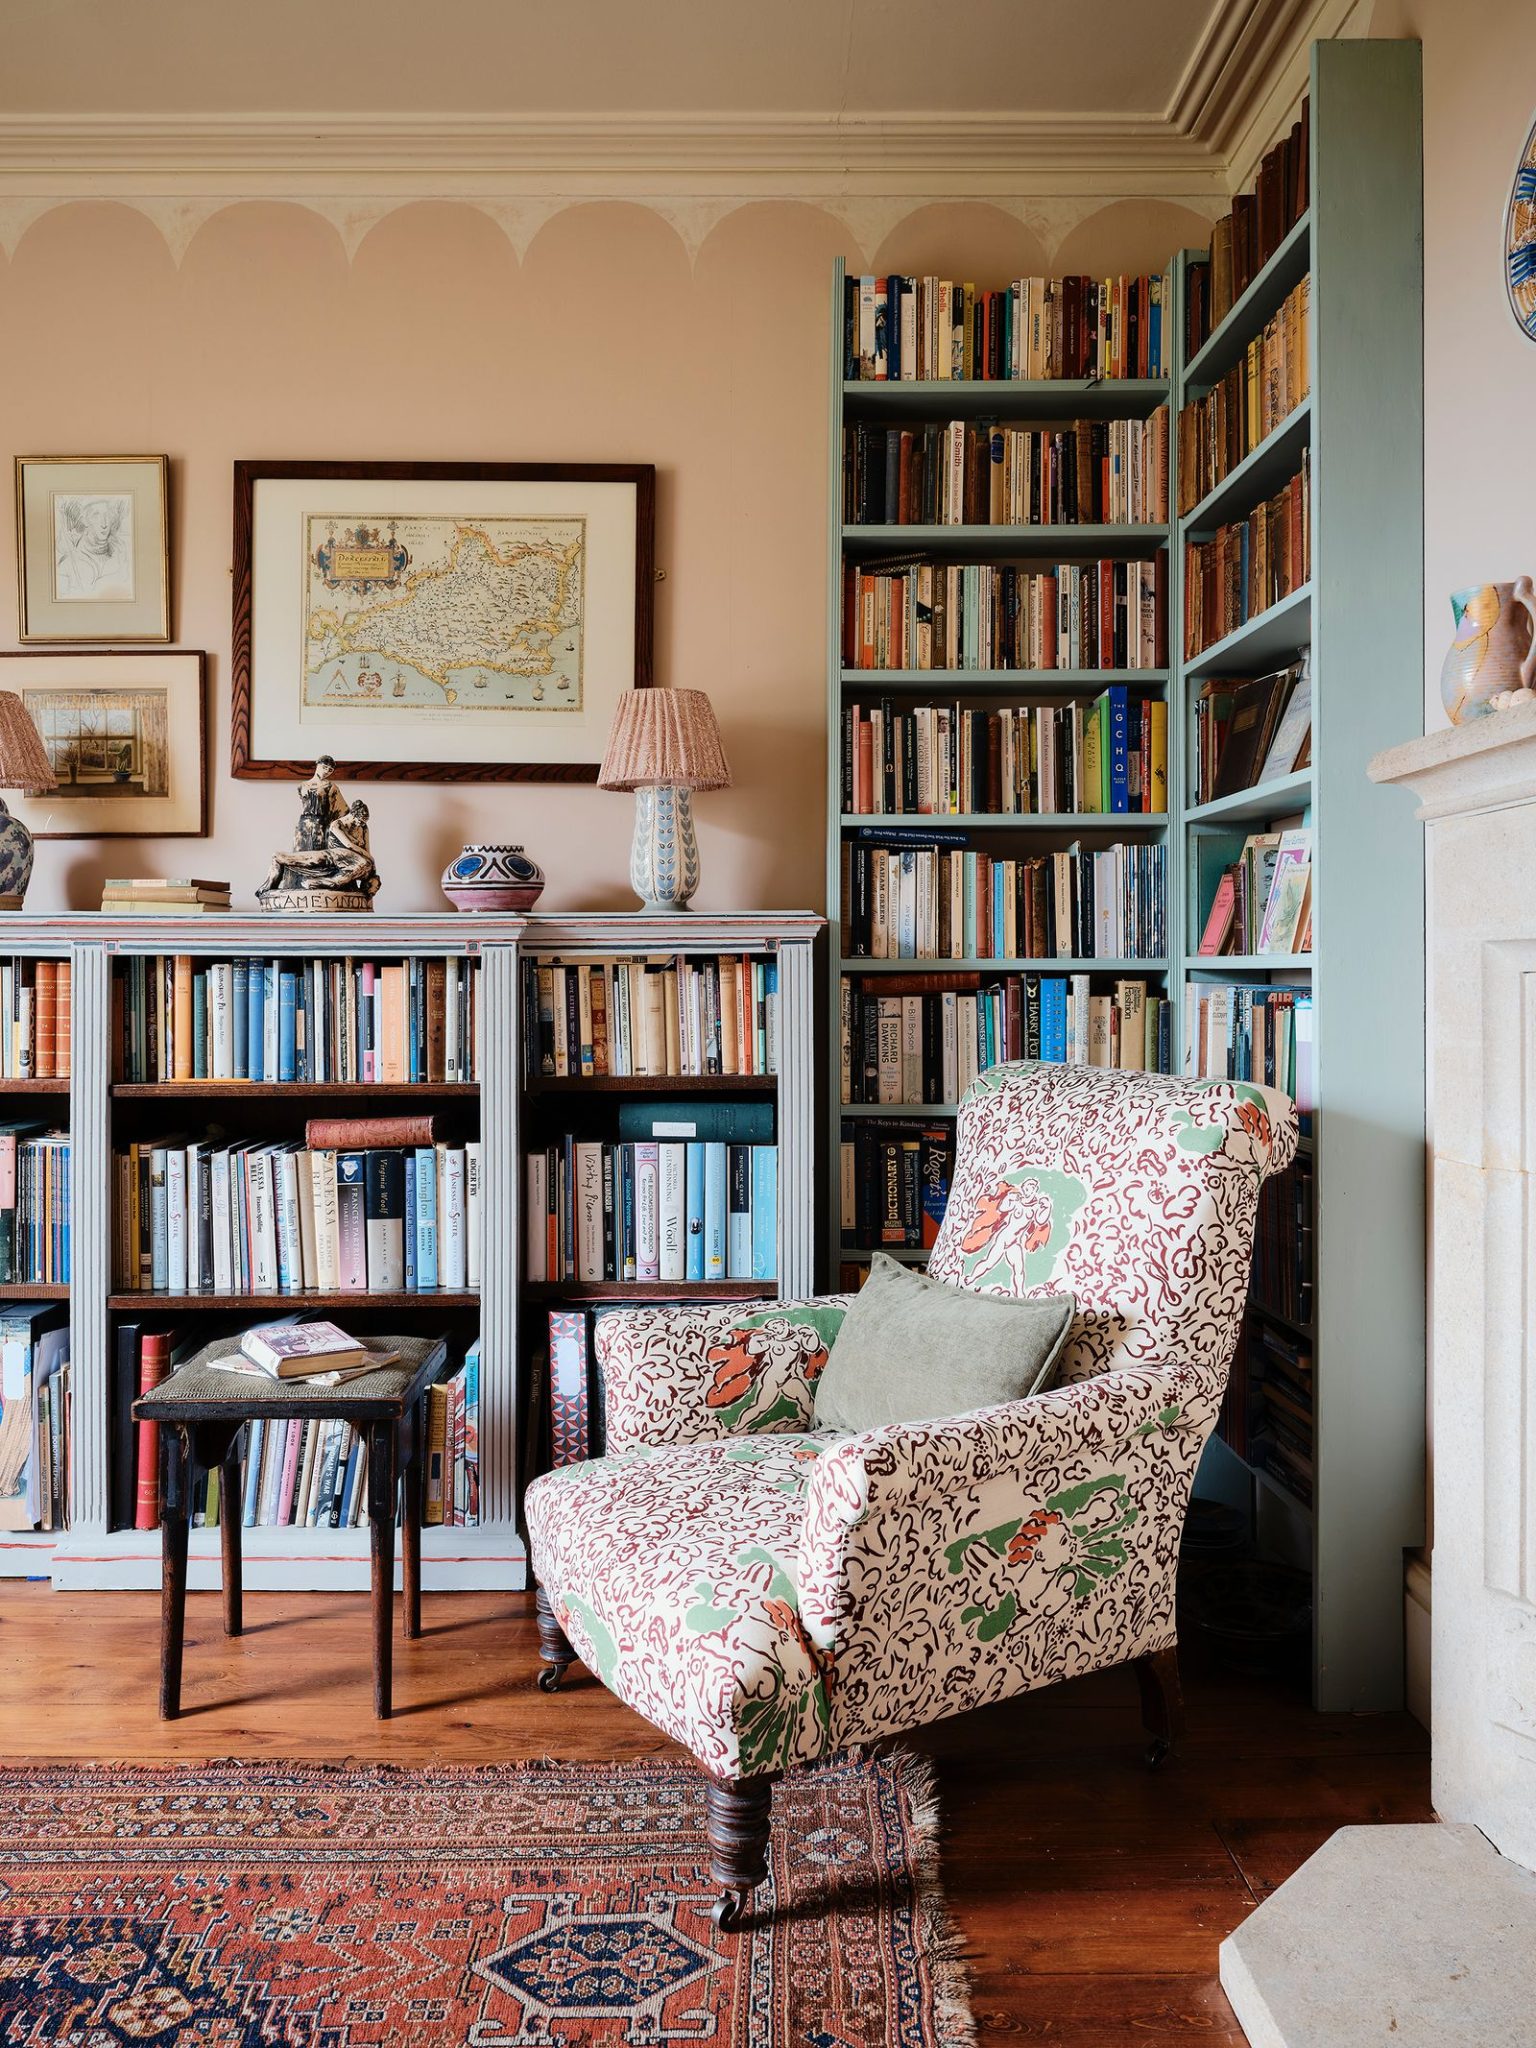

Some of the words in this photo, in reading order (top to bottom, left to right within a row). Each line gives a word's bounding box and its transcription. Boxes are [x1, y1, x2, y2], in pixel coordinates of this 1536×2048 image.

[939, 286, 947, 313] Shells
[954, 427, 963, 439] Ali
[954, 441, 963, 467] Smith
[1160, 478, 1168, 504] TODAY
[908, 1008, 916, 1021] Bill
[1124, 986, 1133, 1020] Fashion
[869, 1005, 877, 1035] DONNA
[978, 1012, 986, 1042] JAPANESE
[1029, 1001, 1039, 1035] HARRY
[881, 1023, 889, 1064] DAWKINS
[889, 1023, 898, 1064] RICHARD
[907, 1023, 916, 1051] Bryson
[979, 1042, 987, 1066] DESIGN
[877, 1119, 892, 1127] Keys
[899, 1120, 926, 1128] Kindness
[256, 1156, 265, 1191] VANESSA
[272, 1153, 282, 1191] QUENTIN
[379, 1158, 388, 1189] Virginia
[581, 1153, 598, 1190] Visiting
[604, 1154, 612, 1174] WOMEN
[904, 1152, 913, 1183] English
[923, 1146, 947, 1198] Roget's
[406, 1172, 414, 1187] The
[417, 1156, 434, 1218] Carrington
[450, 1171, 461, 1203] VANESSA
[470, 1183, 478, 1197] FRY
[887, 1159, 899, 1220] DICTIONARY
[275, 1192, 284, 1213] BELL
[351, 1187, 359, 1225] FRANCES
[379, 1192, 389, 1216] Woolf
[405, 1188, 414, 1209] Angel
[584, 1193, 599, 1223] Picasso
[604, 1181, 613, 1213] BLOOMSBURY
[904, 1184, 914, 1226] Literature
[202, 1204, 210, 1221] Hedge
[407, 1209, 414, 1217] of
[448, 1212, 461, 1238] SISTER
[406, 1217, 415, 1255] Charleston
[665, 1216, 678, 1255] Woolf
[532, 1368, 541, 1382] Lee
[531, 1383, 540, 1404] Miller
[446, 1388, 455, 1438] CHARLESTON
[51, 1426, 58, 1434] OF
[301, 1435, 307, 1444] AT
[298, 1446, 307, 1467] HOME
[324, 1445, 337, 1478] WOMAN'S
[293, 1491, 301, 1506] TODD
[323, 1479, 332, 1495] WAR
